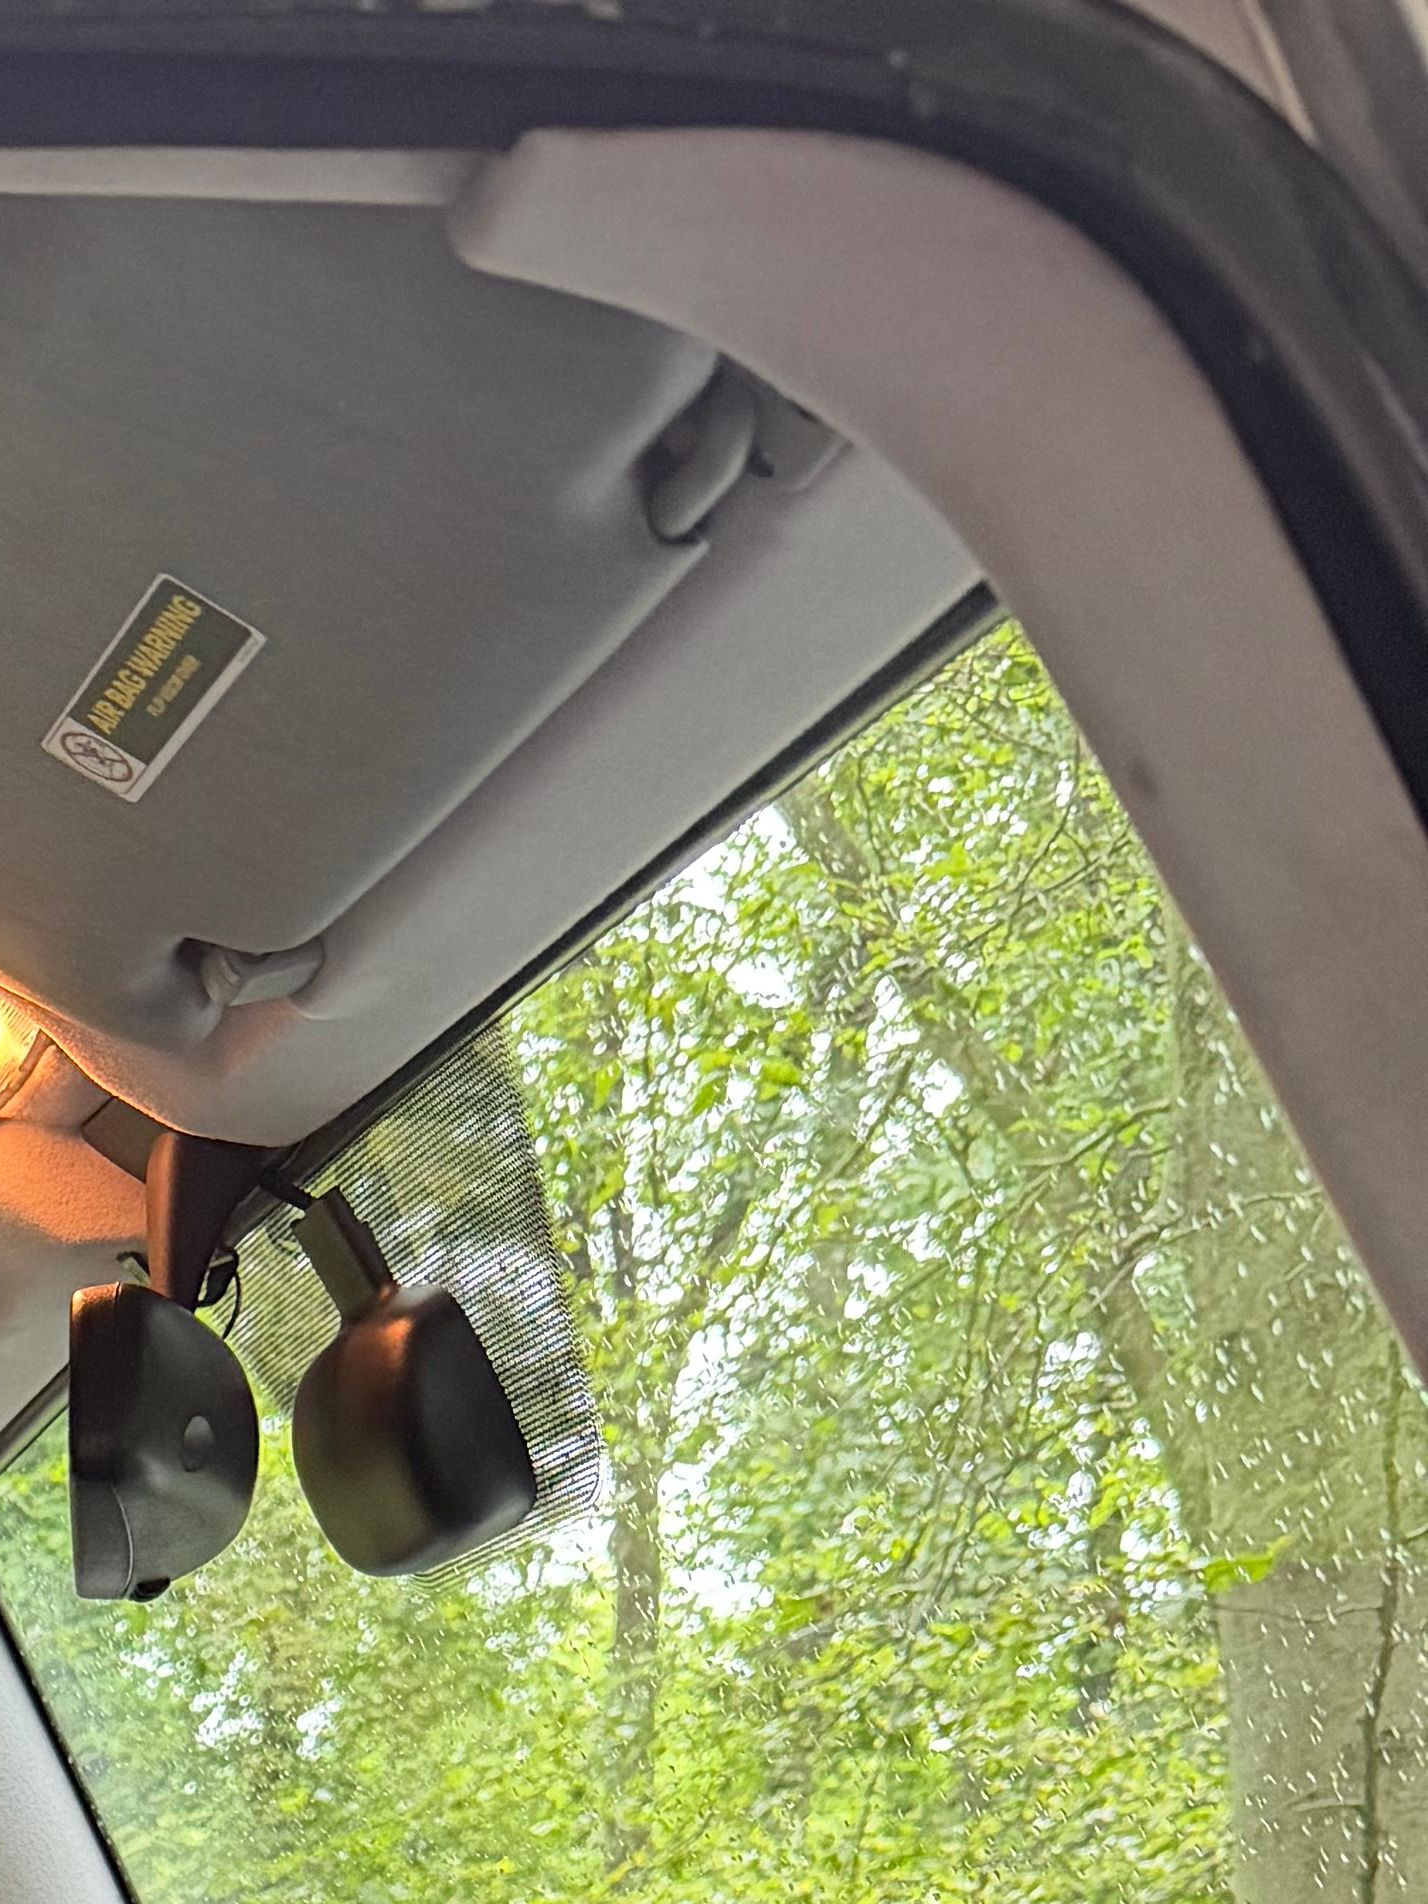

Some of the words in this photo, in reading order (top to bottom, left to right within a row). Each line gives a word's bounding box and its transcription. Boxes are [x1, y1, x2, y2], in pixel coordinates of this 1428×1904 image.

[125, 595, 201, 677] WARNING
[104, 669, 147, 710] BAG
[87, 700, 126, 735] AIR
